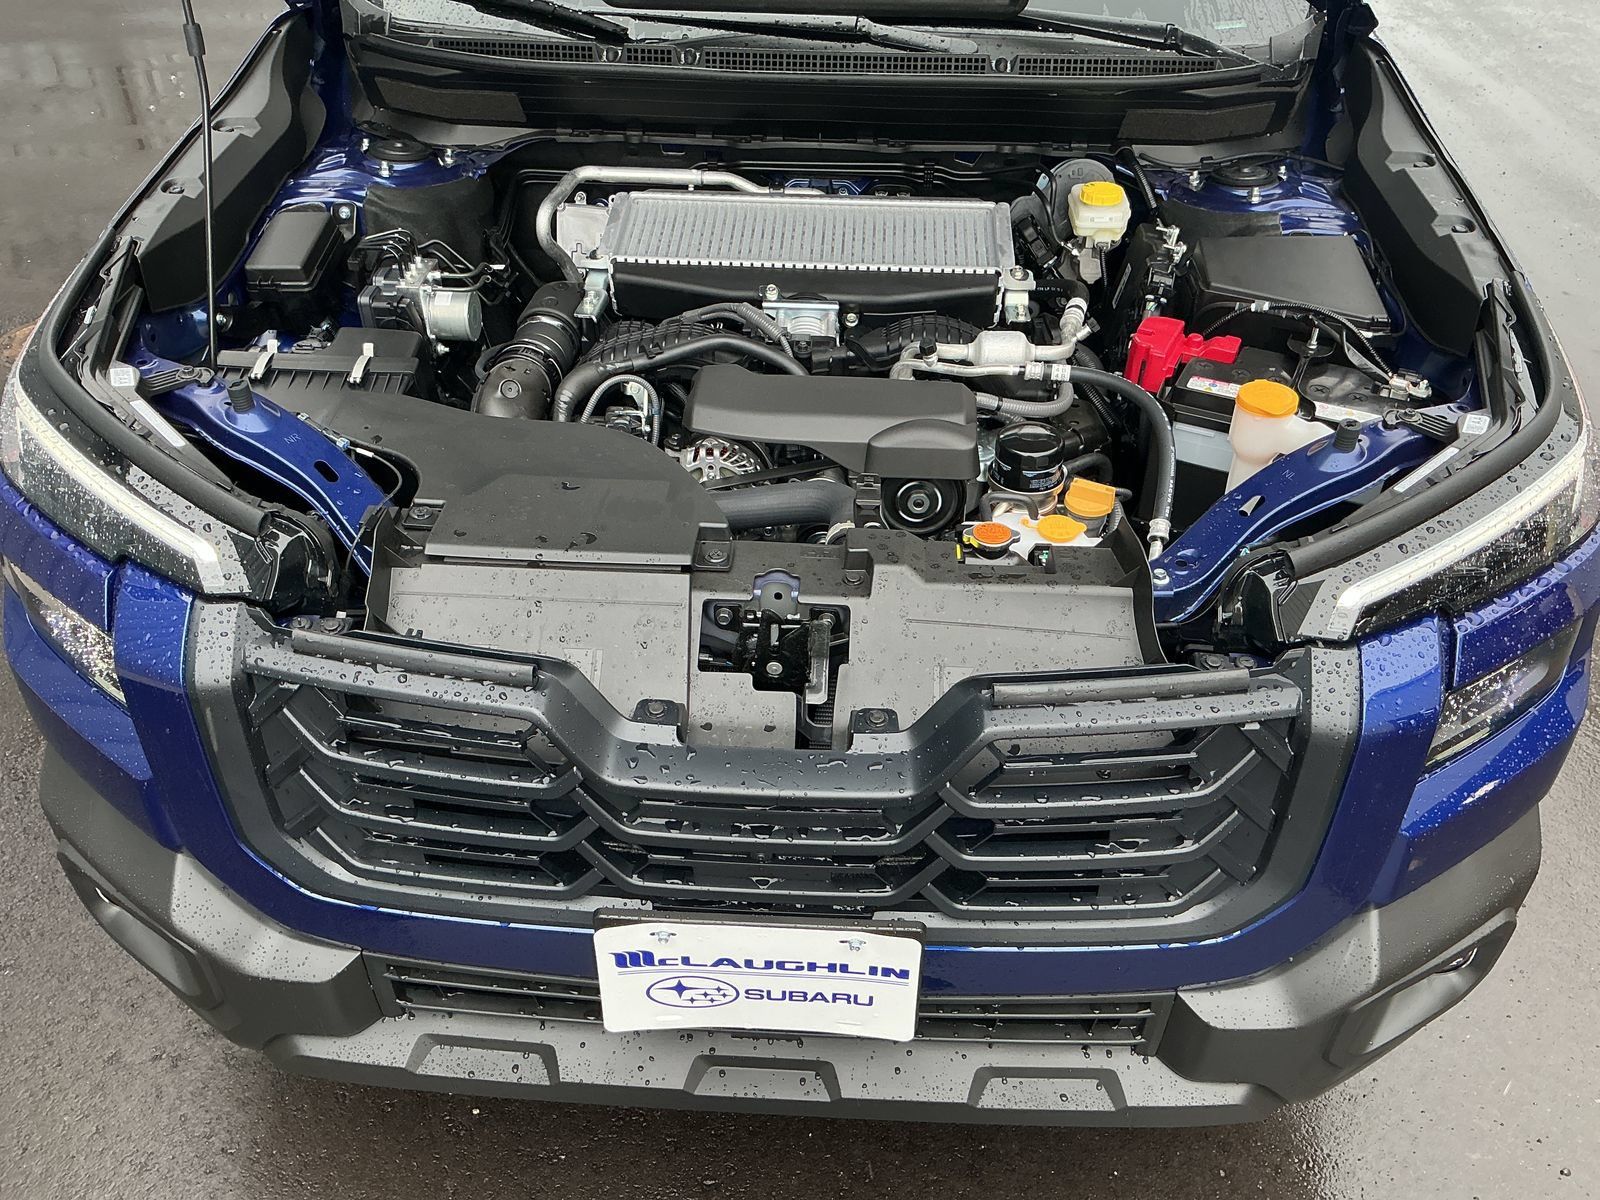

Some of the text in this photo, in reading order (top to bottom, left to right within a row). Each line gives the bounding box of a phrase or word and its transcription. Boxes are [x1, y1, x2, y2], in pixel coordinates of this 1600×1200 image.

[283, 433, 302, 444] NR
[1281, 469, 1295, 480] NL
[744, 989, 874, 1006] SUBARU
